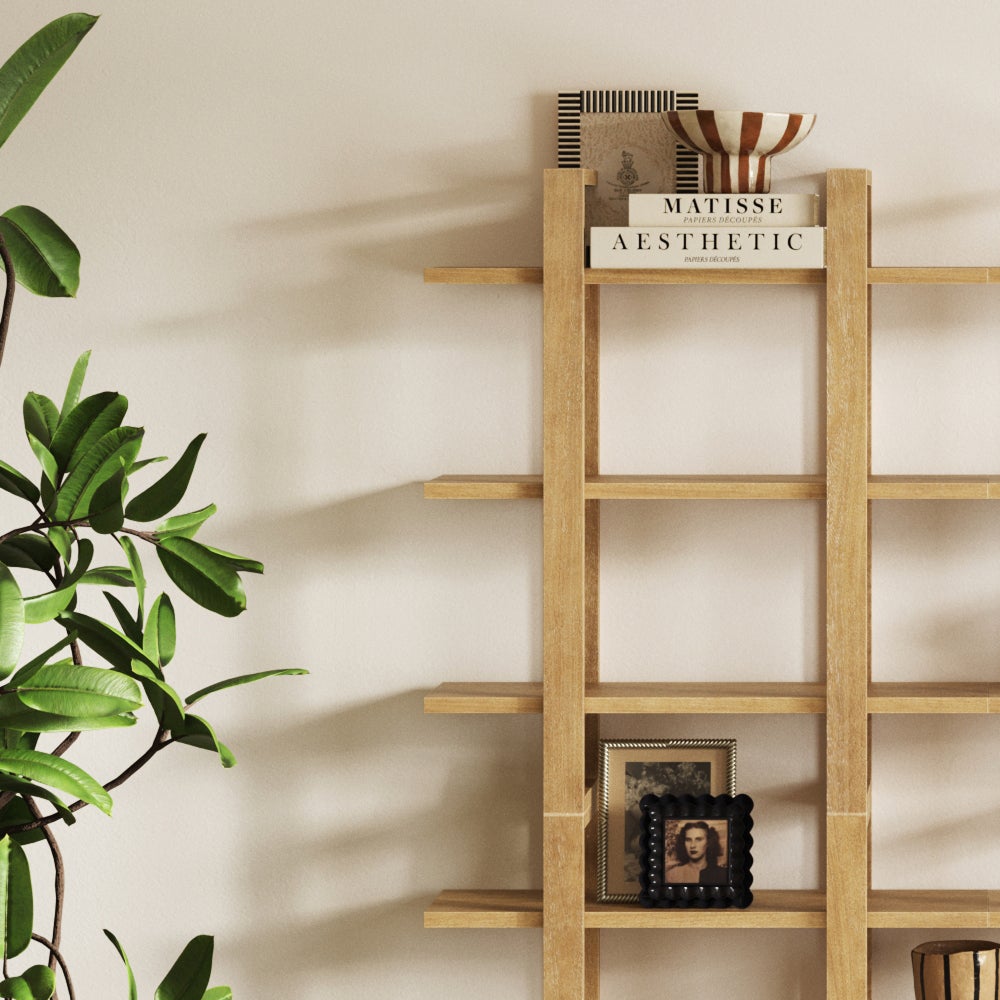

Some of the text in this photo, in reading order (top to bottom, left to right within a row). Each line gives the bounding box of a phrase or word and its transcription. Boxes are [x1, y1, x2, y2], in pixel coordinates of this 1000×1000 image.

[663, 197, 783, 214] MATISSE
[683, 215, 763, 224] PAPIERS DÉCOUPÉS
[612, 233, 803, 251] AESTHETIC
[709, 255, 740, 263] DÉCOUPÉS
